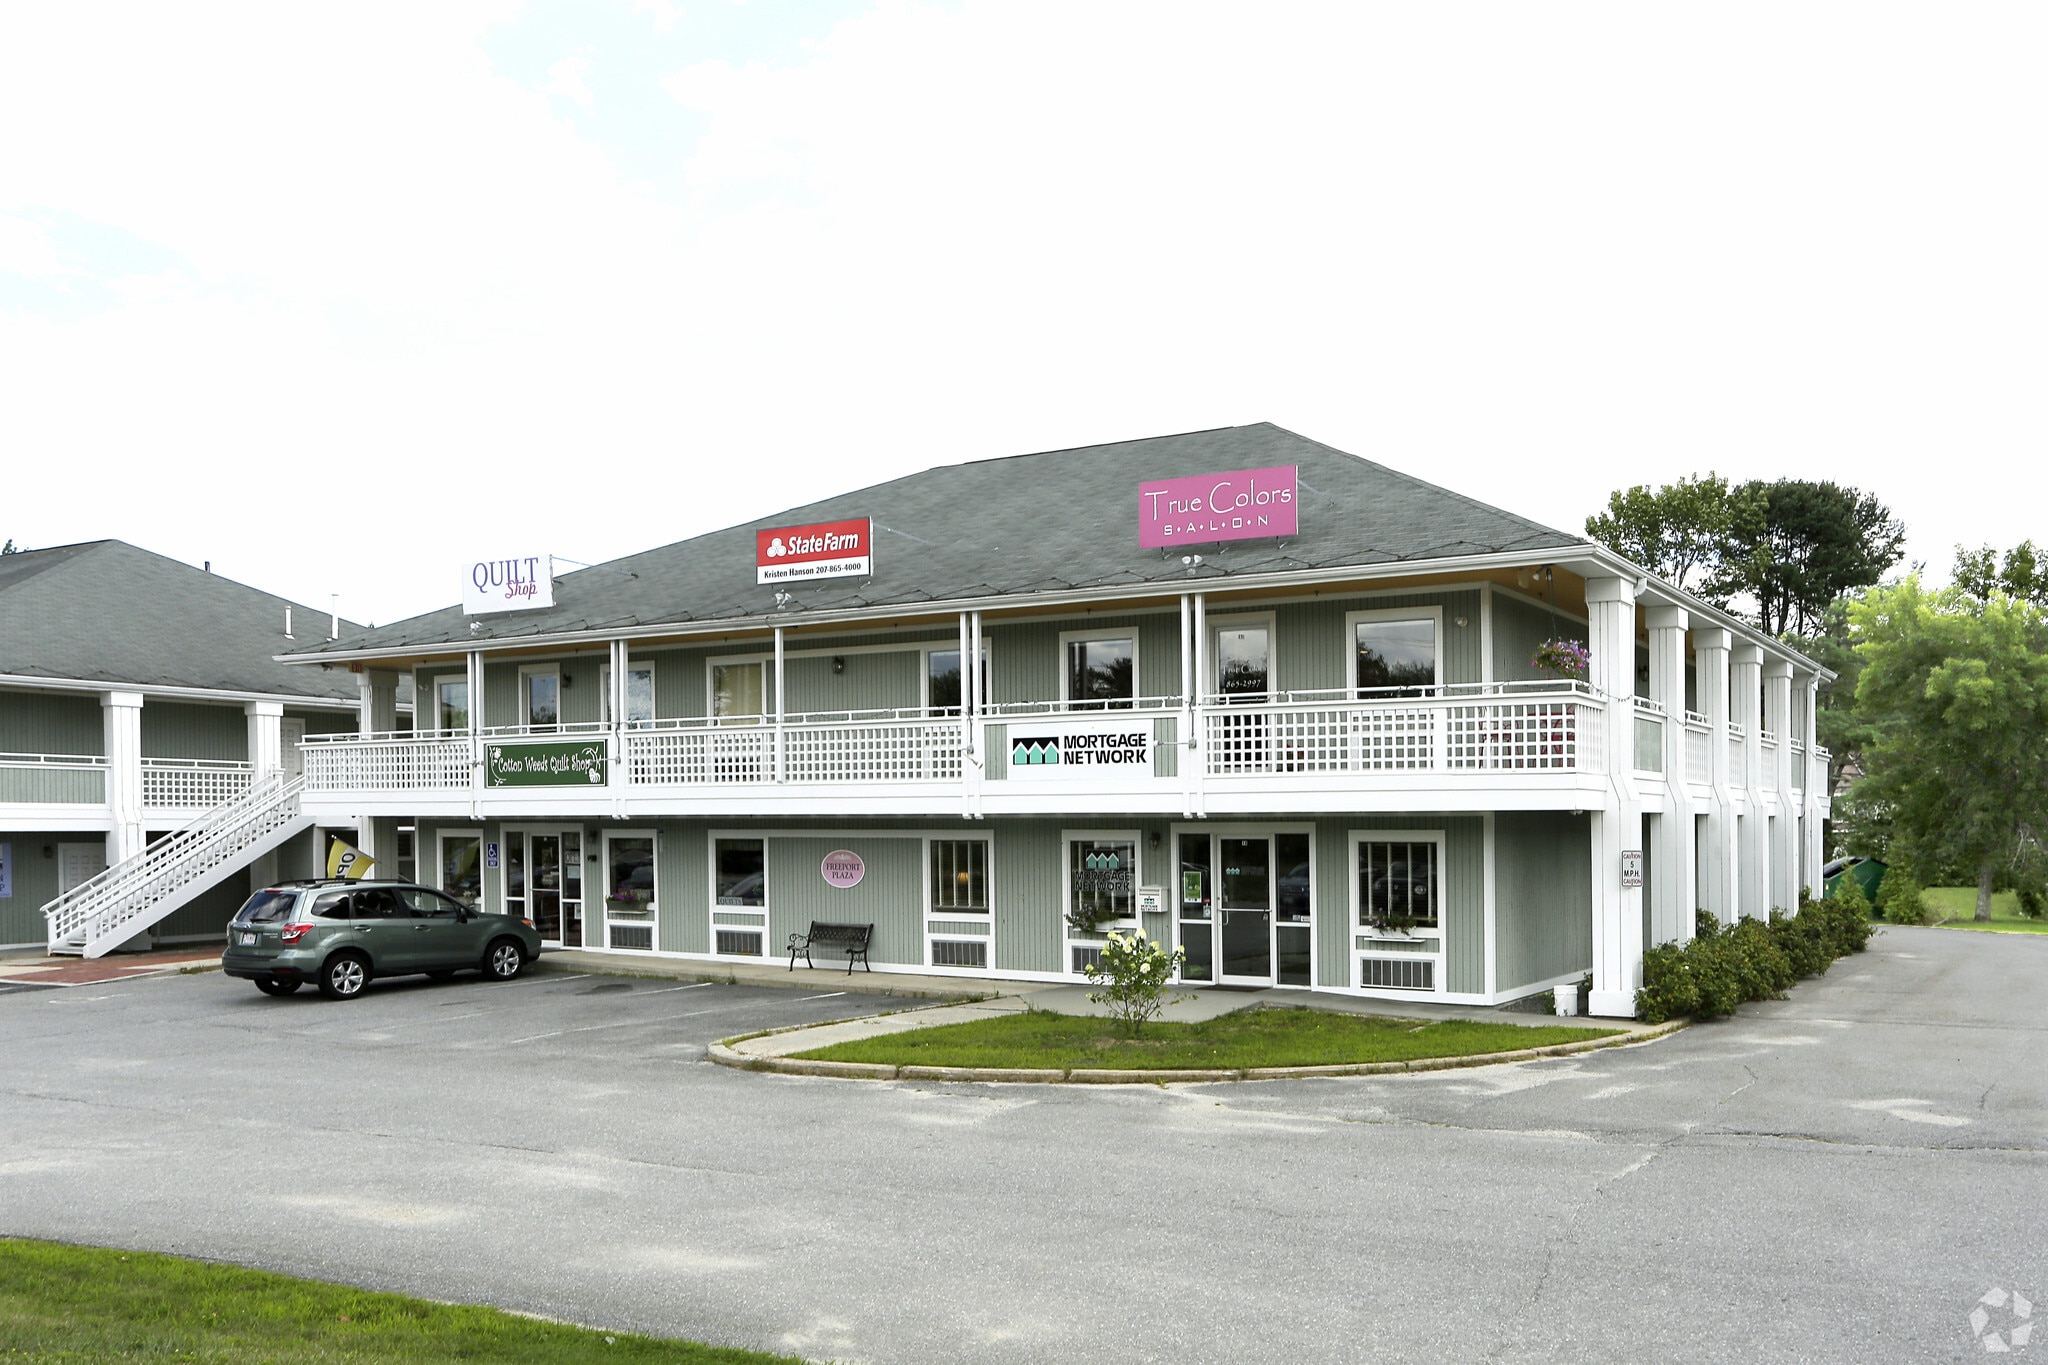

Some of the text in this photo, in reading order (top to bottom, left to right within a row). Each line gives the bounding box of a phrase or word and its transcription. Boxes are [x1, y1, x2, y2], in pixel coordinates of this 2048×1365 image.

[1144, 479, 1292, 520] True Colors
[788, 532, 858, 555] StateFarm
[473, 557, 538, 593] QUILT
[764, 562, 861, 579] Kristen Hanson 207-865-4000
[504, 580, 538, 600] Shop
[1063, 733, 1147, 749] MORTGAGE
[498, 752, 591, 775] Cotton Weeds Quilt Shop
[1063, 749, 1147, 765] NETWORK
[336, 853, 356, 879] OP
[826, 862, 860, 871] FREEPORT
[832, 871, 854, 879] PLAZA
[1075, 871, 1130, 880] MORTGAGE
[1075, 881, 1130, 891] NETWORK
